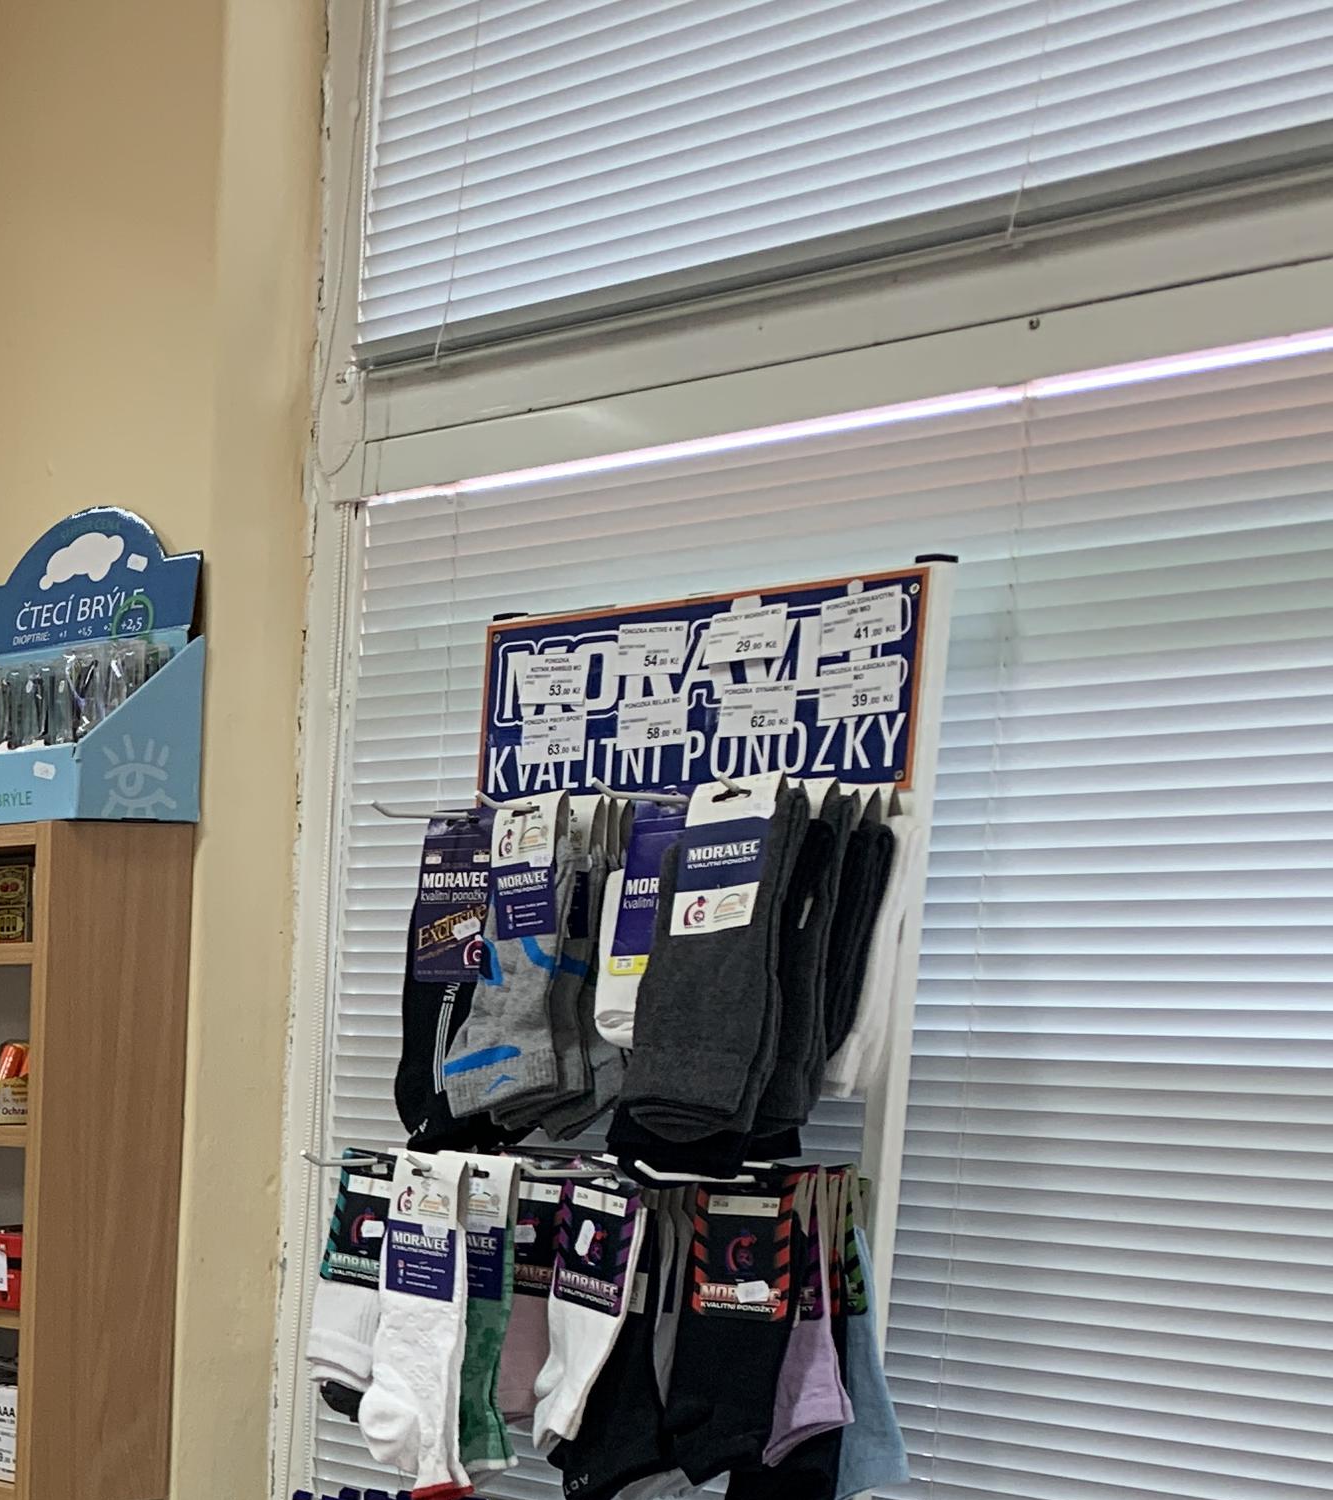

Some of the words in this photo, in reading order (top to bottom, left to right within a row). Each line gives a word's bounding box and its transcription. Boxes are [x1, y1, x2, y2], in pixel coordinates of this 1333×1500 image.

[15, 593, 75, 632] ČTECÍ
[120, 616, 144, 632] +2,5
[687, 838, 761, 864] MORAVEC
[421, 871, 489, 889] MORAVEC
[496, 869, 549, 891] MORAVEC
[420, 889, 451, 901] kvalitní
[451, 889, 489, 904] ponožky
[622, 897, 655, 910] kvalitní
[391, 1230, 450, 1252] MORAVEC
[328, 1253, 380, 1271] MORAVE
[559, 1269, 619, 1298] MORAVEC
